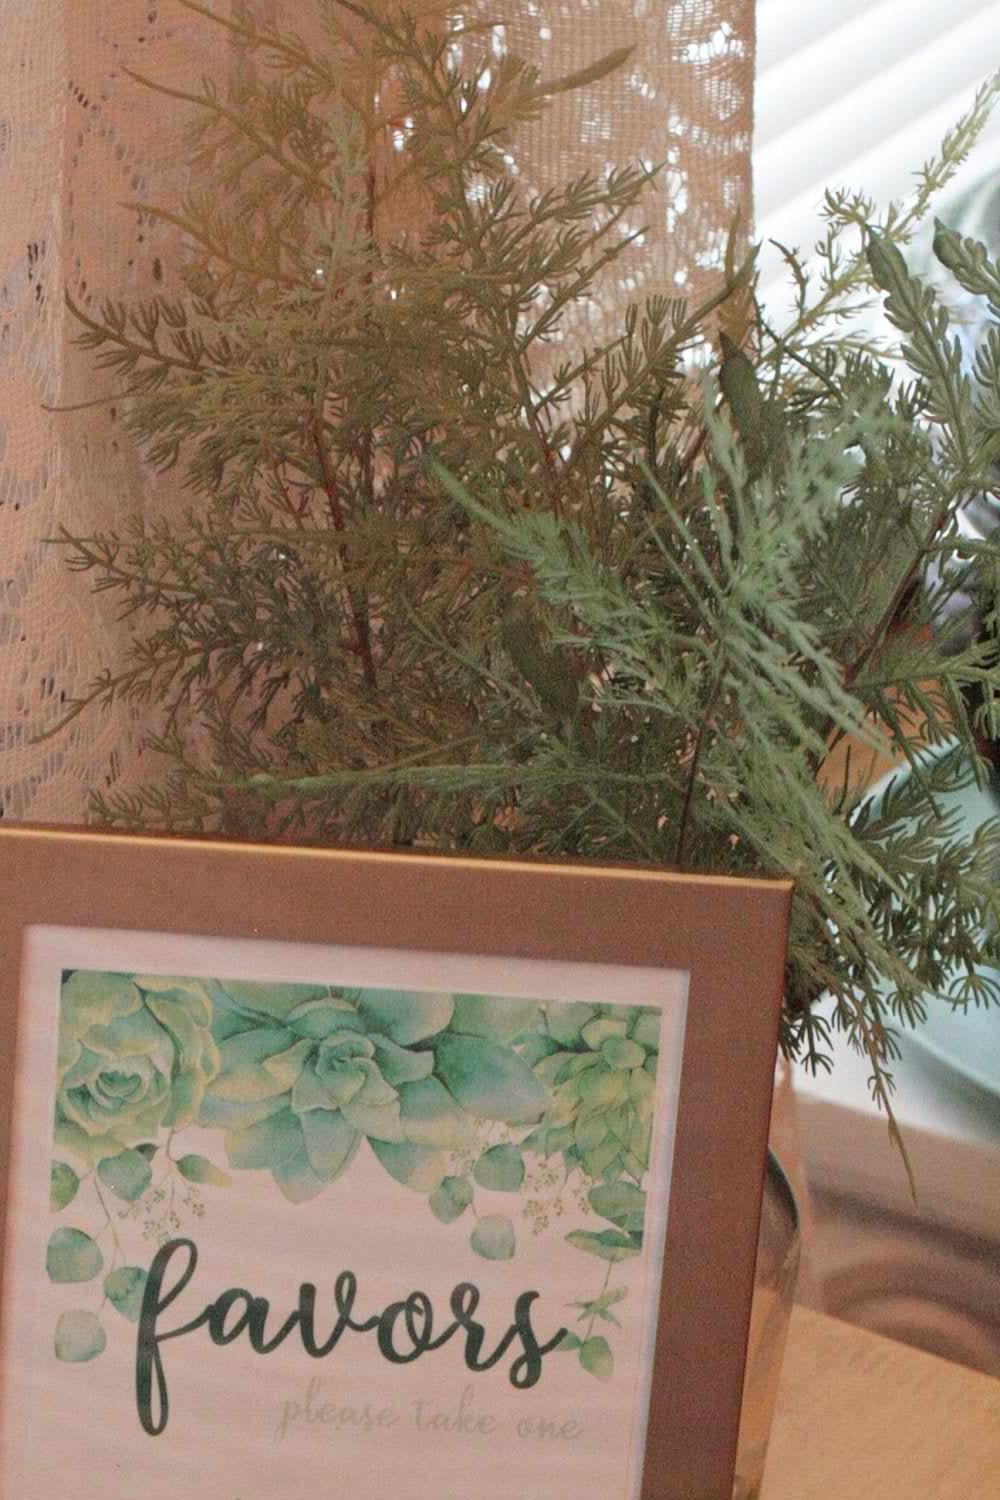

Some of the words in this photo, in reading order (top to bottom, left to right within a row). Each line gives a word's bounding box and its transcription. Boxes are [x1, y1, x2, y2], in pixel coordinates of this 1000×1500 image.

[135, 1238, 568, 1436] favors
[276, 1374, 399, 1445] please
[413, 1385, 497, 1440] take
[516, 1418, 583, 1442] one
